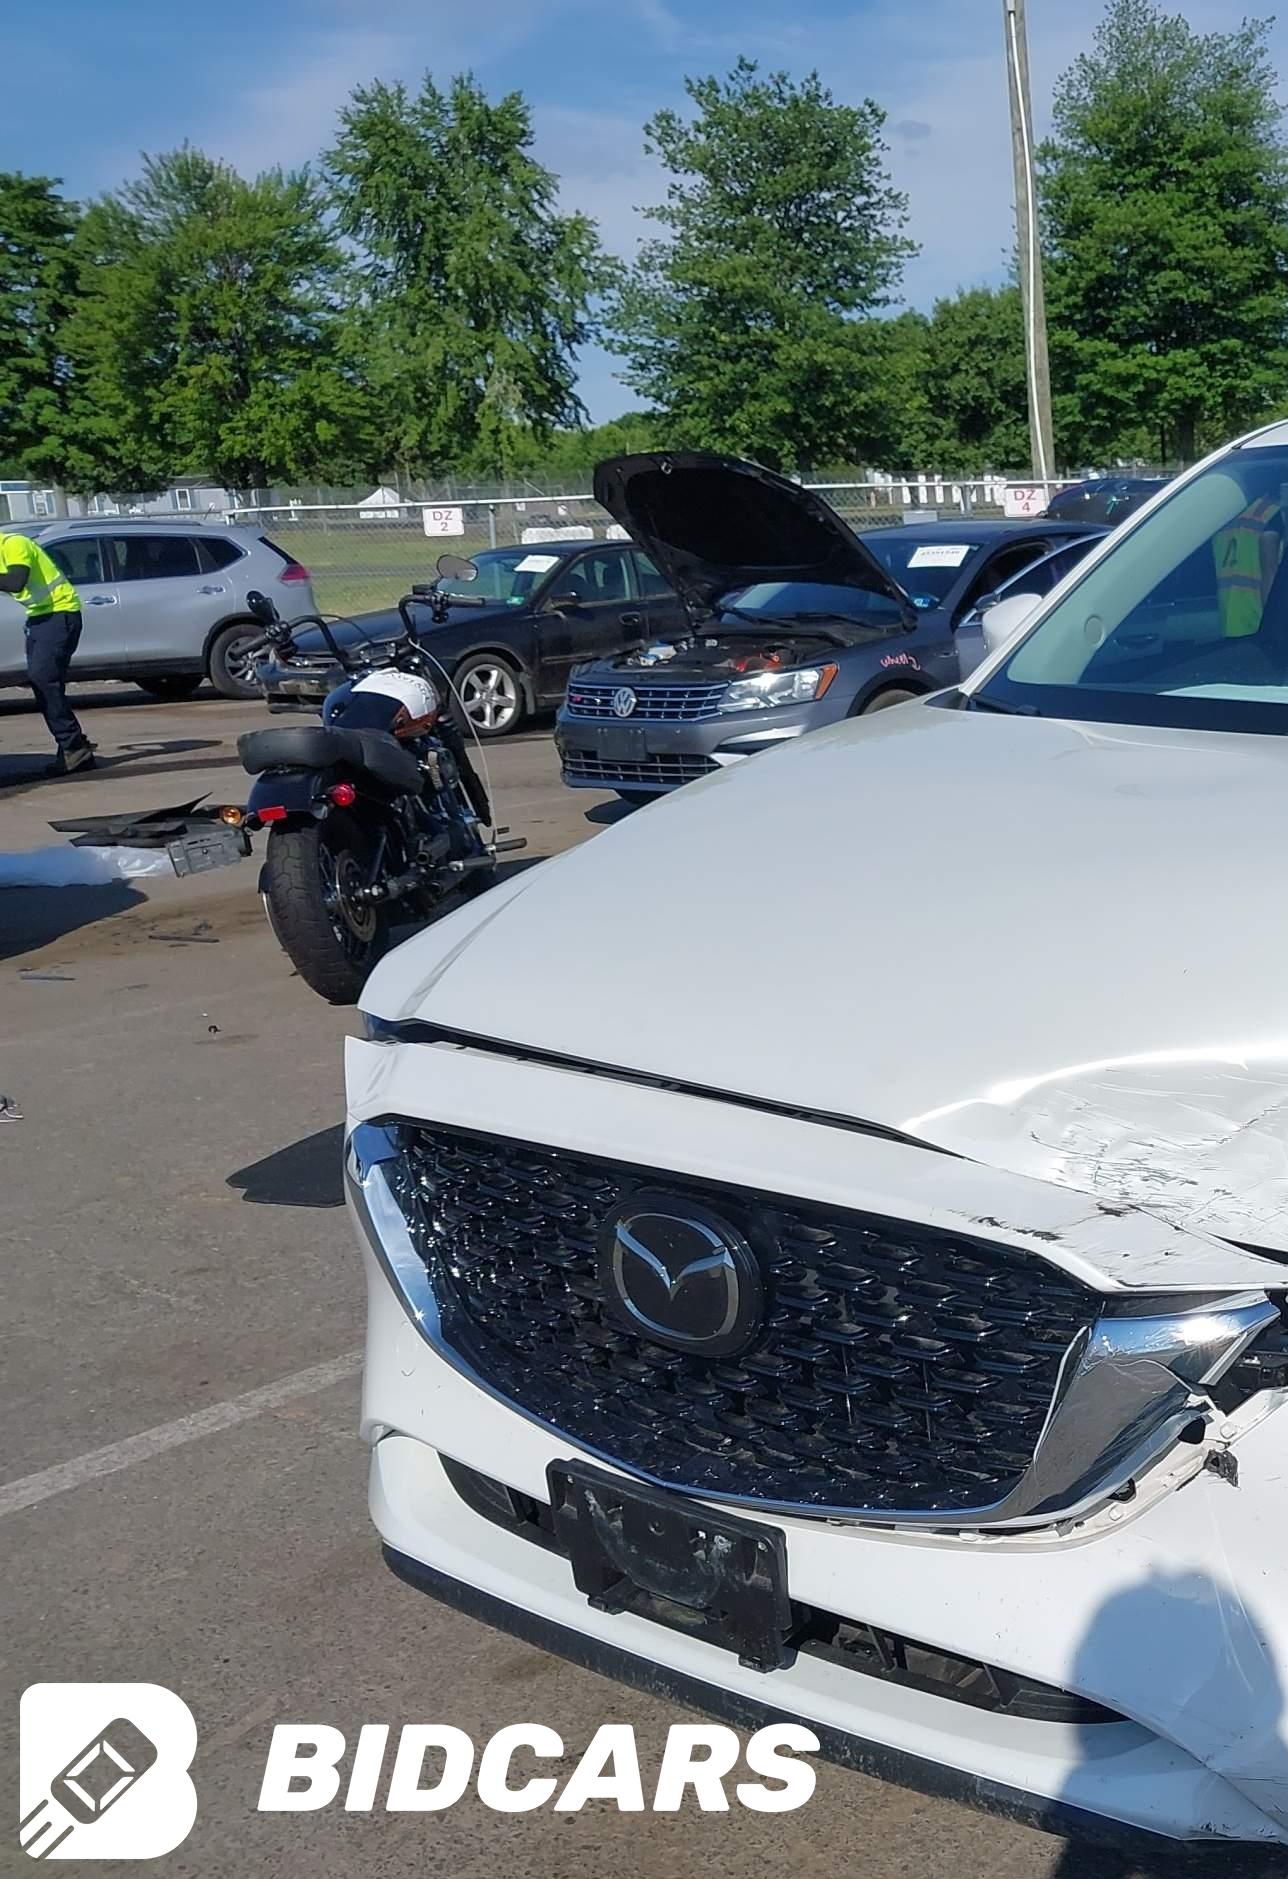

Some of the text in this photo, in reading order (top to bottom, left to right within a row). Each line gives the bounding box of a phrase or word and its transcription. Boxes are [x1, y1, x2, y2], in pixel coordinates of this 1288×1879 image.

[1014, 489, 1036, 501] DZ
[1022, 501, 1031, 512] 4
[432, 510, 453, 521] DZ
[440, 521, 448, 532] 2
